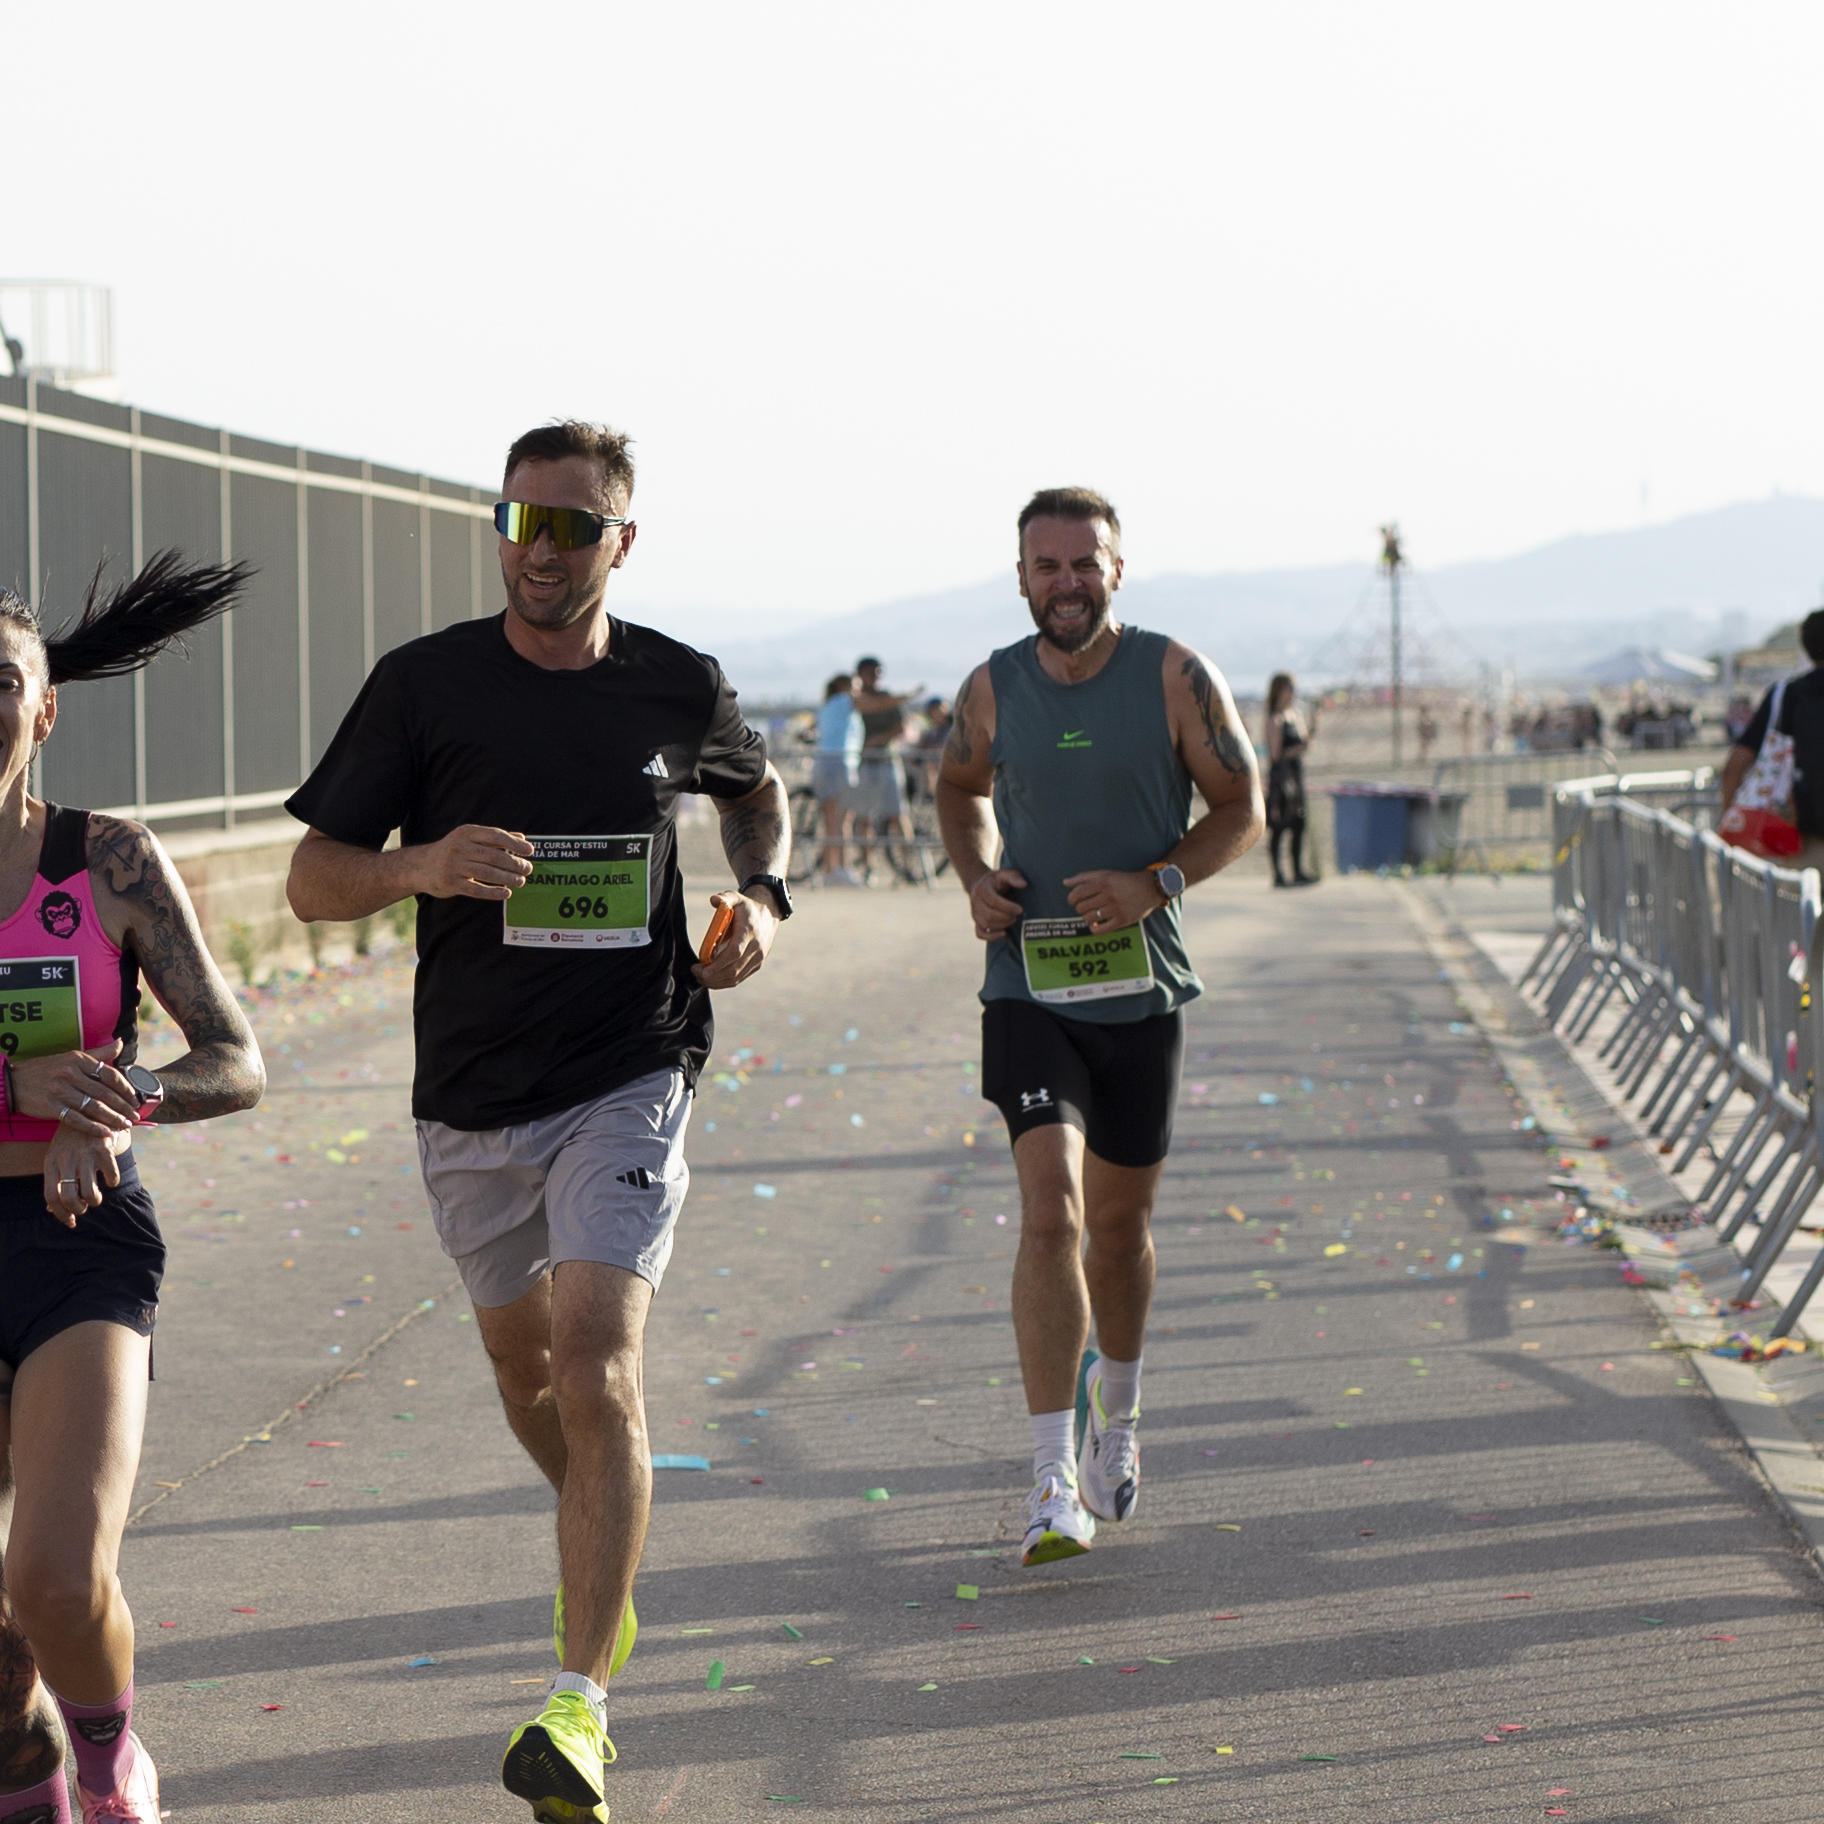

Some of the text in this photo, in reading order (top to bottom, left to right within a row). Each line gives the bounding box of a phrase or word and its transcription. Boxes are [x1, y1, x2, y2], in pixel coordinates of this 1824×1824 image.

[543, 841, 572, 849] CURSA
[626, 842, 641, 854] 5K
[547, 850, 558, 858] DE
[560, 850, 580, 858] MAR
[526, 873, 634, 886] SANTIAGO ARIEL
[558, 896, 609, 919] 696
[1037, 937, 1132, 960] SALVADOR
[41, 966, 64, 980] 5K
[1068, 959, 1110, 978] 592
